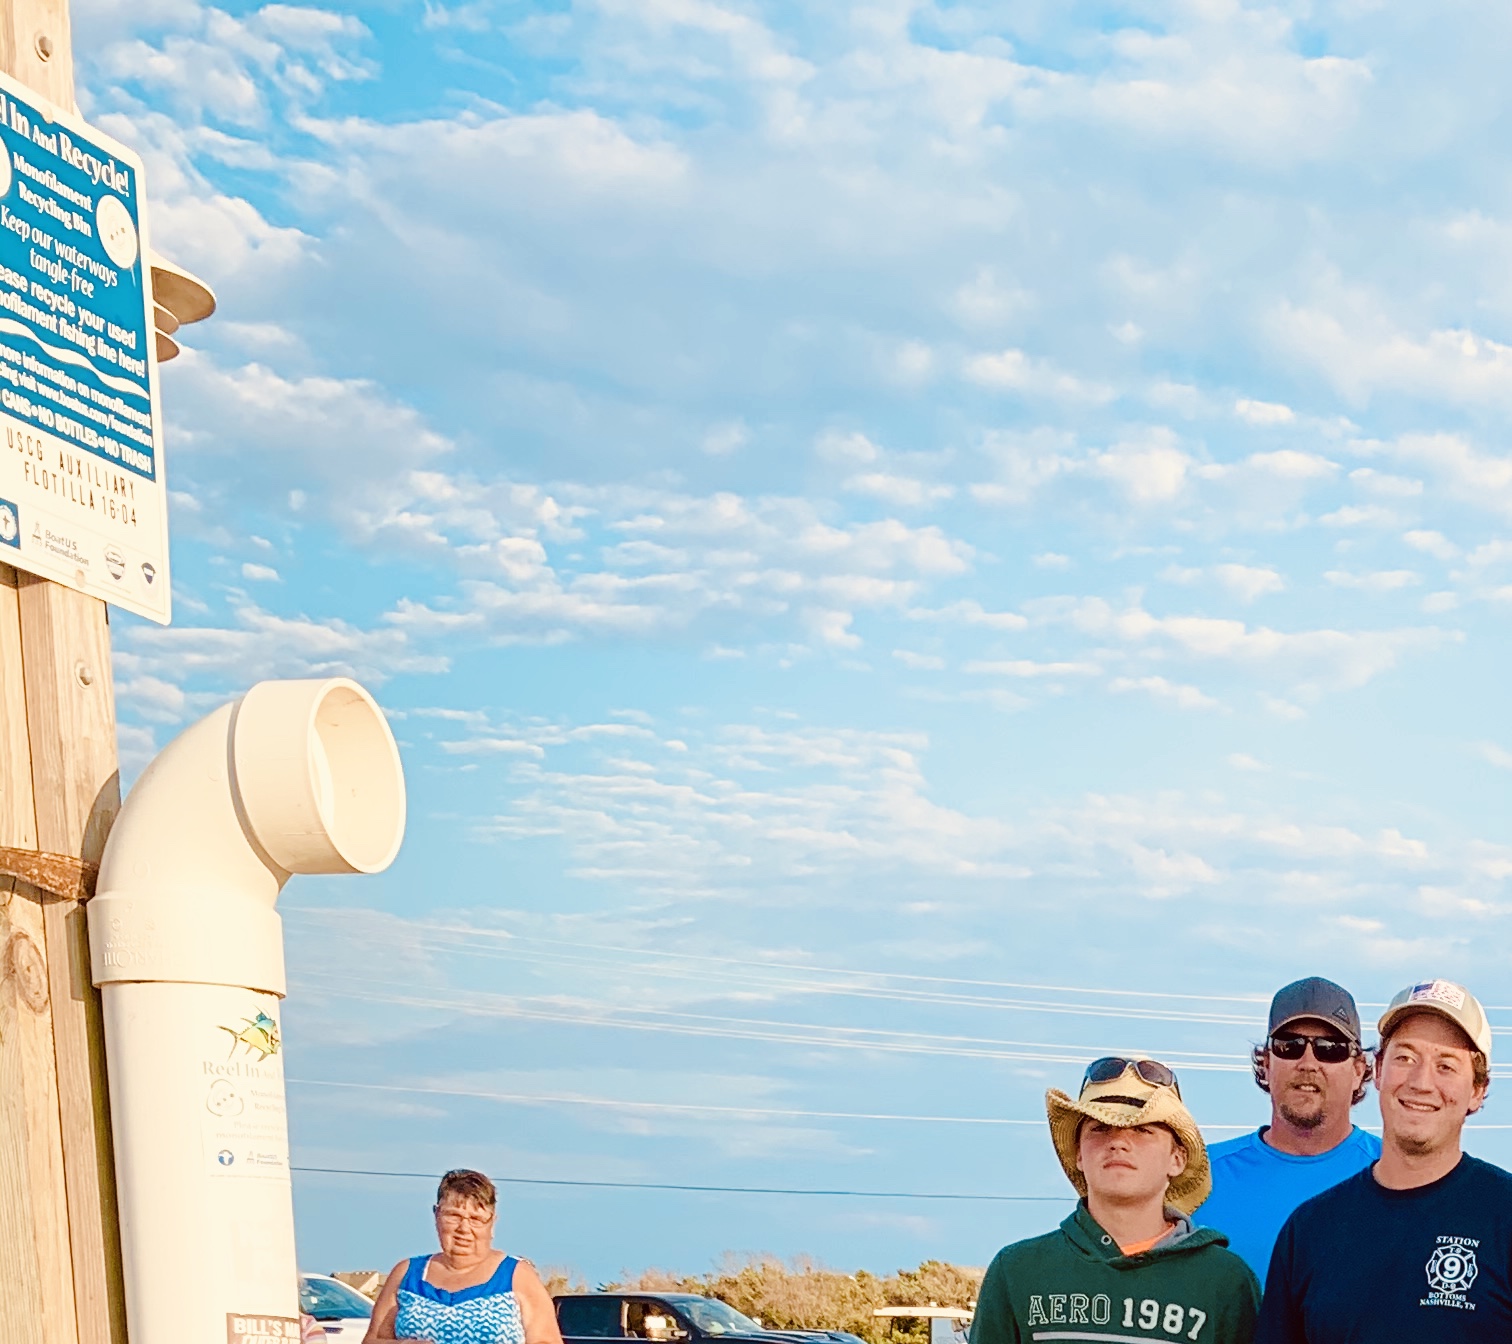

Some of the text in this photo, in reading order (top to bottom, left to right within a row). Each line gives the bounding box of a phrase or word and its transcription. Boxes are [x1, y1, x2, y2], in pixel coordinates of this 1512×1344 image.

[10, 101, 30, 140] In
[33, 125, 58, 156] And
[59, 132, 130, 198] Recycle!
[13, 152, 93, 213] Monofilament
[18, 181, 92, 238] Recycling Bin
[1, 204, 118, 288] Keep our waterways
[30, 248, 94, 299] tangle-free
[30, 281, 75, 318] recycle
[78, 305, 105, 331] your
[107, 322, 136, 350] used
[59, 319, 95, 357] fishing
[98, 337, 117, 363] line
[118, 347, 145, 379] here!
[23, 352, 77, 393] information
[78, 382, 90, 400] on
[91, 388, 152, 430] monofilament
[6, 427, 134, 501] USCG AUXILIARY
[24, 461, 95, 511] FLOTILLA
[203, 1060, 240, 1077] Reel
[1436, 1236, 1480, 1248] STATION
[1443, 1257, 1461, 1278] 9
[1028, 1294, 1206, 1340] AERO 1987
[1420, 1298, 1476, 1310] NASHVILLE, TN
[1428, 1291, 1467, 1302] BOTTOMS
[234, 1317, 283, 1337] BILL'S
